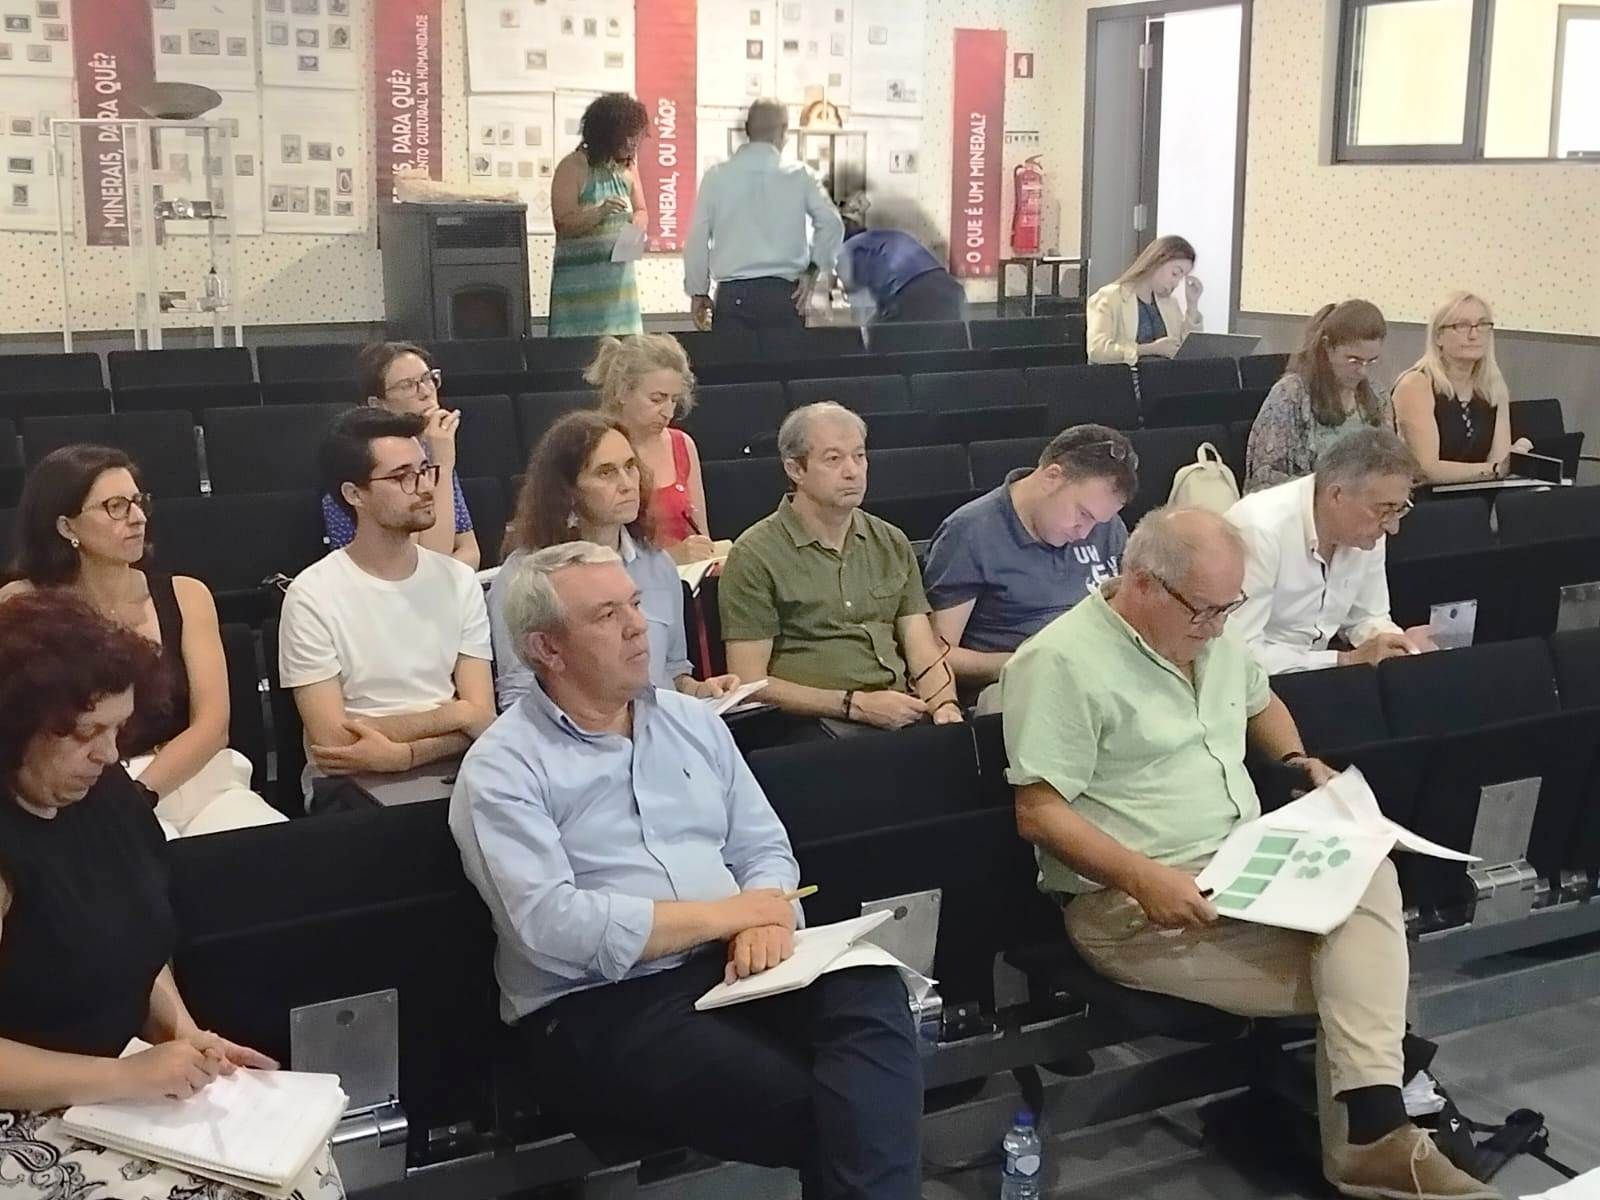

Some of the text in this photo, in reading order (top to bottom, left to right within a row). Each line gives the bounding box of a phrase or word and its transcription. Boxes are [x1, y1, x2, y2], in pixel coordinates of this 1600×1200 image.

[416, 14, 429, 79] HUMANIDADE
[88, 52, 121, 94] QUÊ?
[386, 69, 415, 108] QUÊ?
[416, 81, 429, 95] DA
[97, 99, 120, 142] PARA
[392, 113, 412, 154] PARA
[416, 98, 429, 145] CULTURAL
[654, 97, 677, 139] NÃO?
[658, 143, 677, 166] OU
[969, 112, 986, 177] MINERAL?
[100, 149, 125, 227] MINERAIS,
[659, 171, 680, 237] MINERAL,
[968, 181, 984, 203] UM
[964, 207, 983, 216] É
[966, 219, 984, 247] QUE
[966, 251, 982, 263] O
